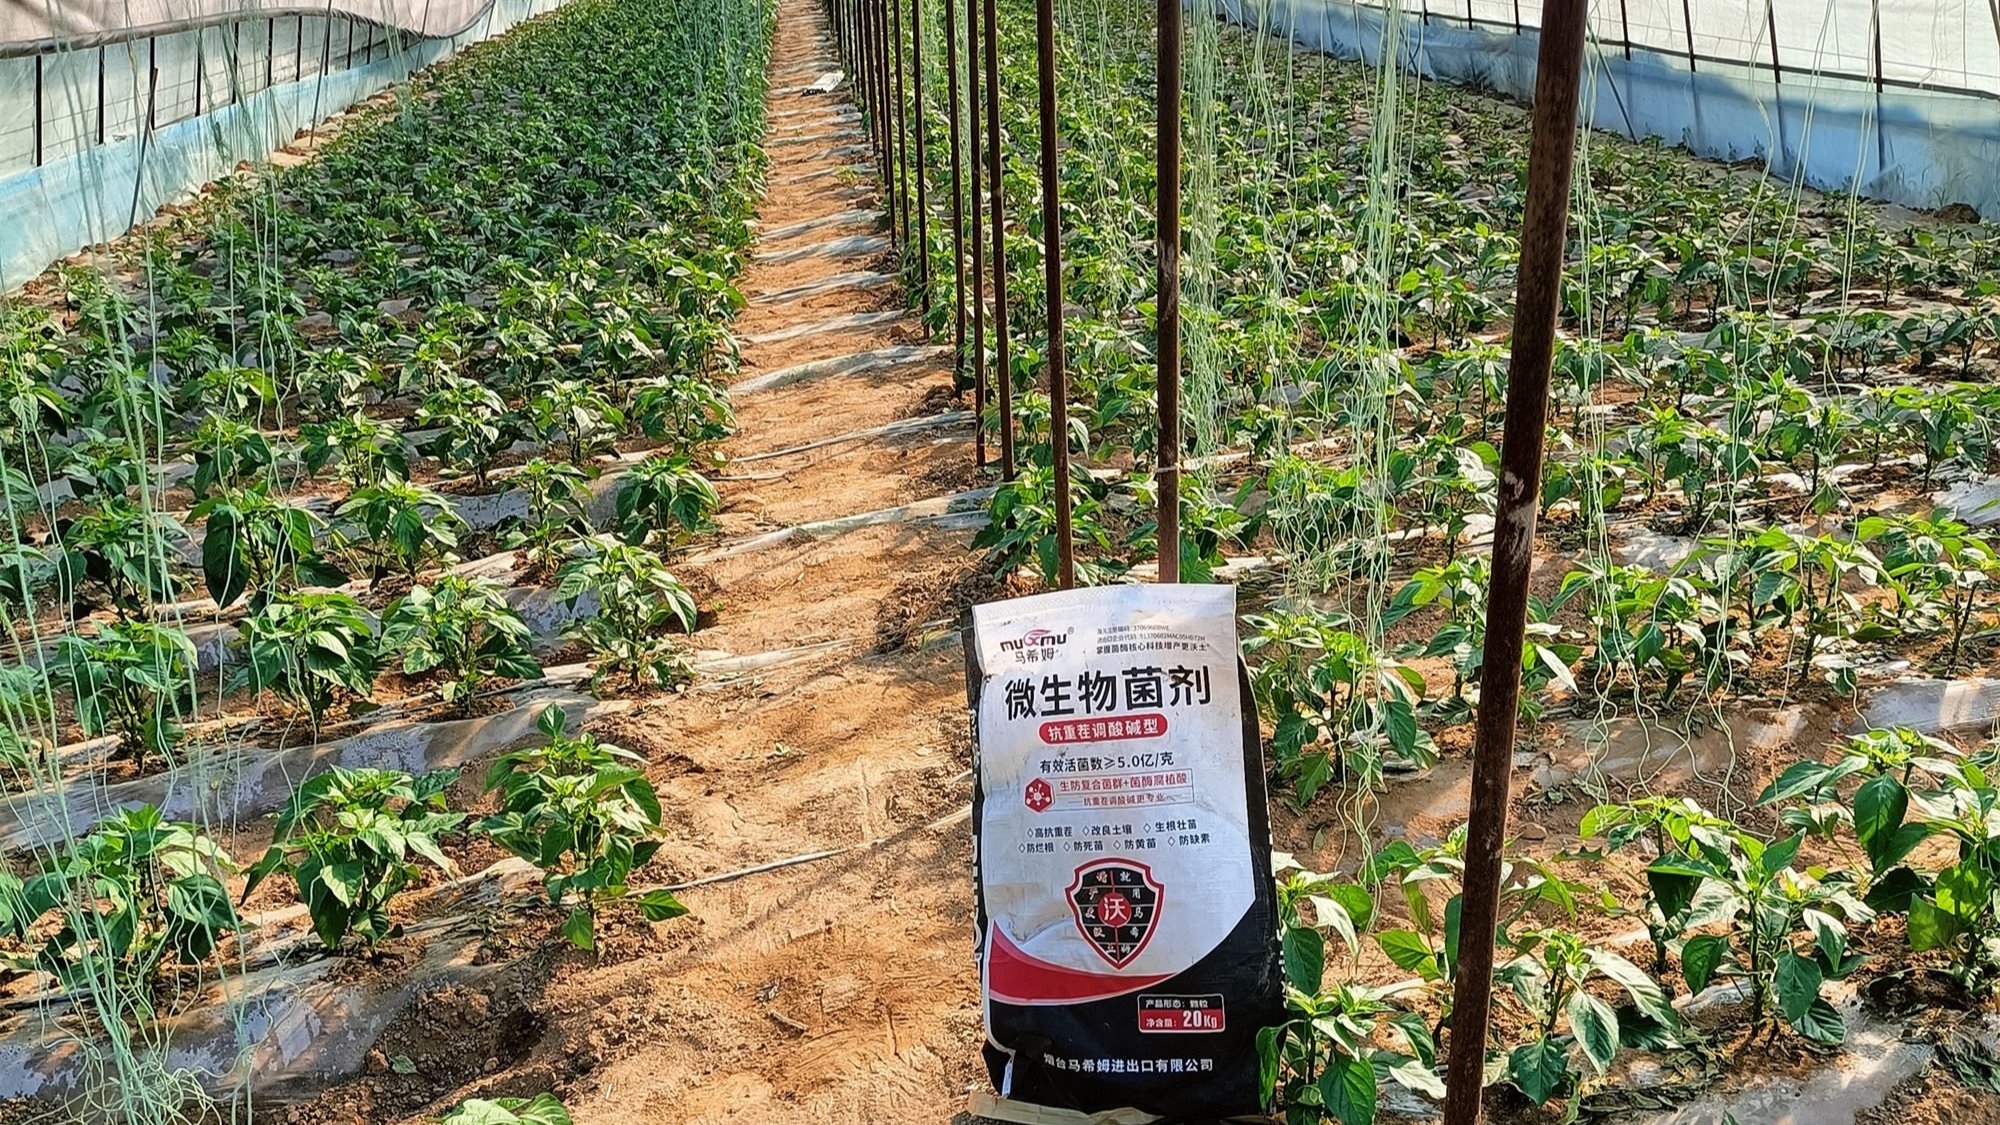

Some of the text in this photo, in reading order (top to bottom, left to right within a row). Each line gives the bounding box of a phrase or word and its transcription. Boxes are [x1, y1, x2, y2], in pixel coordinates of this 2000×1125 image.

[1015, 648, 1054, 664] 马希姆
[1005, 664, 1211, 721] 微生物菌剂
[1047, 718, 1159, 742] 抗重茬调酸碱型
[1040, 752, 1174, 774] 有效活菌数≥5.0亿/克
[1059, 772, 1188, 792] 生防复合菌群+菌酶腐植酸
[1034, 819, 1197, 838] 高抗重茬 改良土壤 生根壮苗
[1026, 833, 1211, 854] 防烂根 防死苗 防黄苗 防缺素
[1103, 897, 1128, 921] 沃
[1043, 1052, 1213, 1073] 烟台马希姆进出口有限公司
